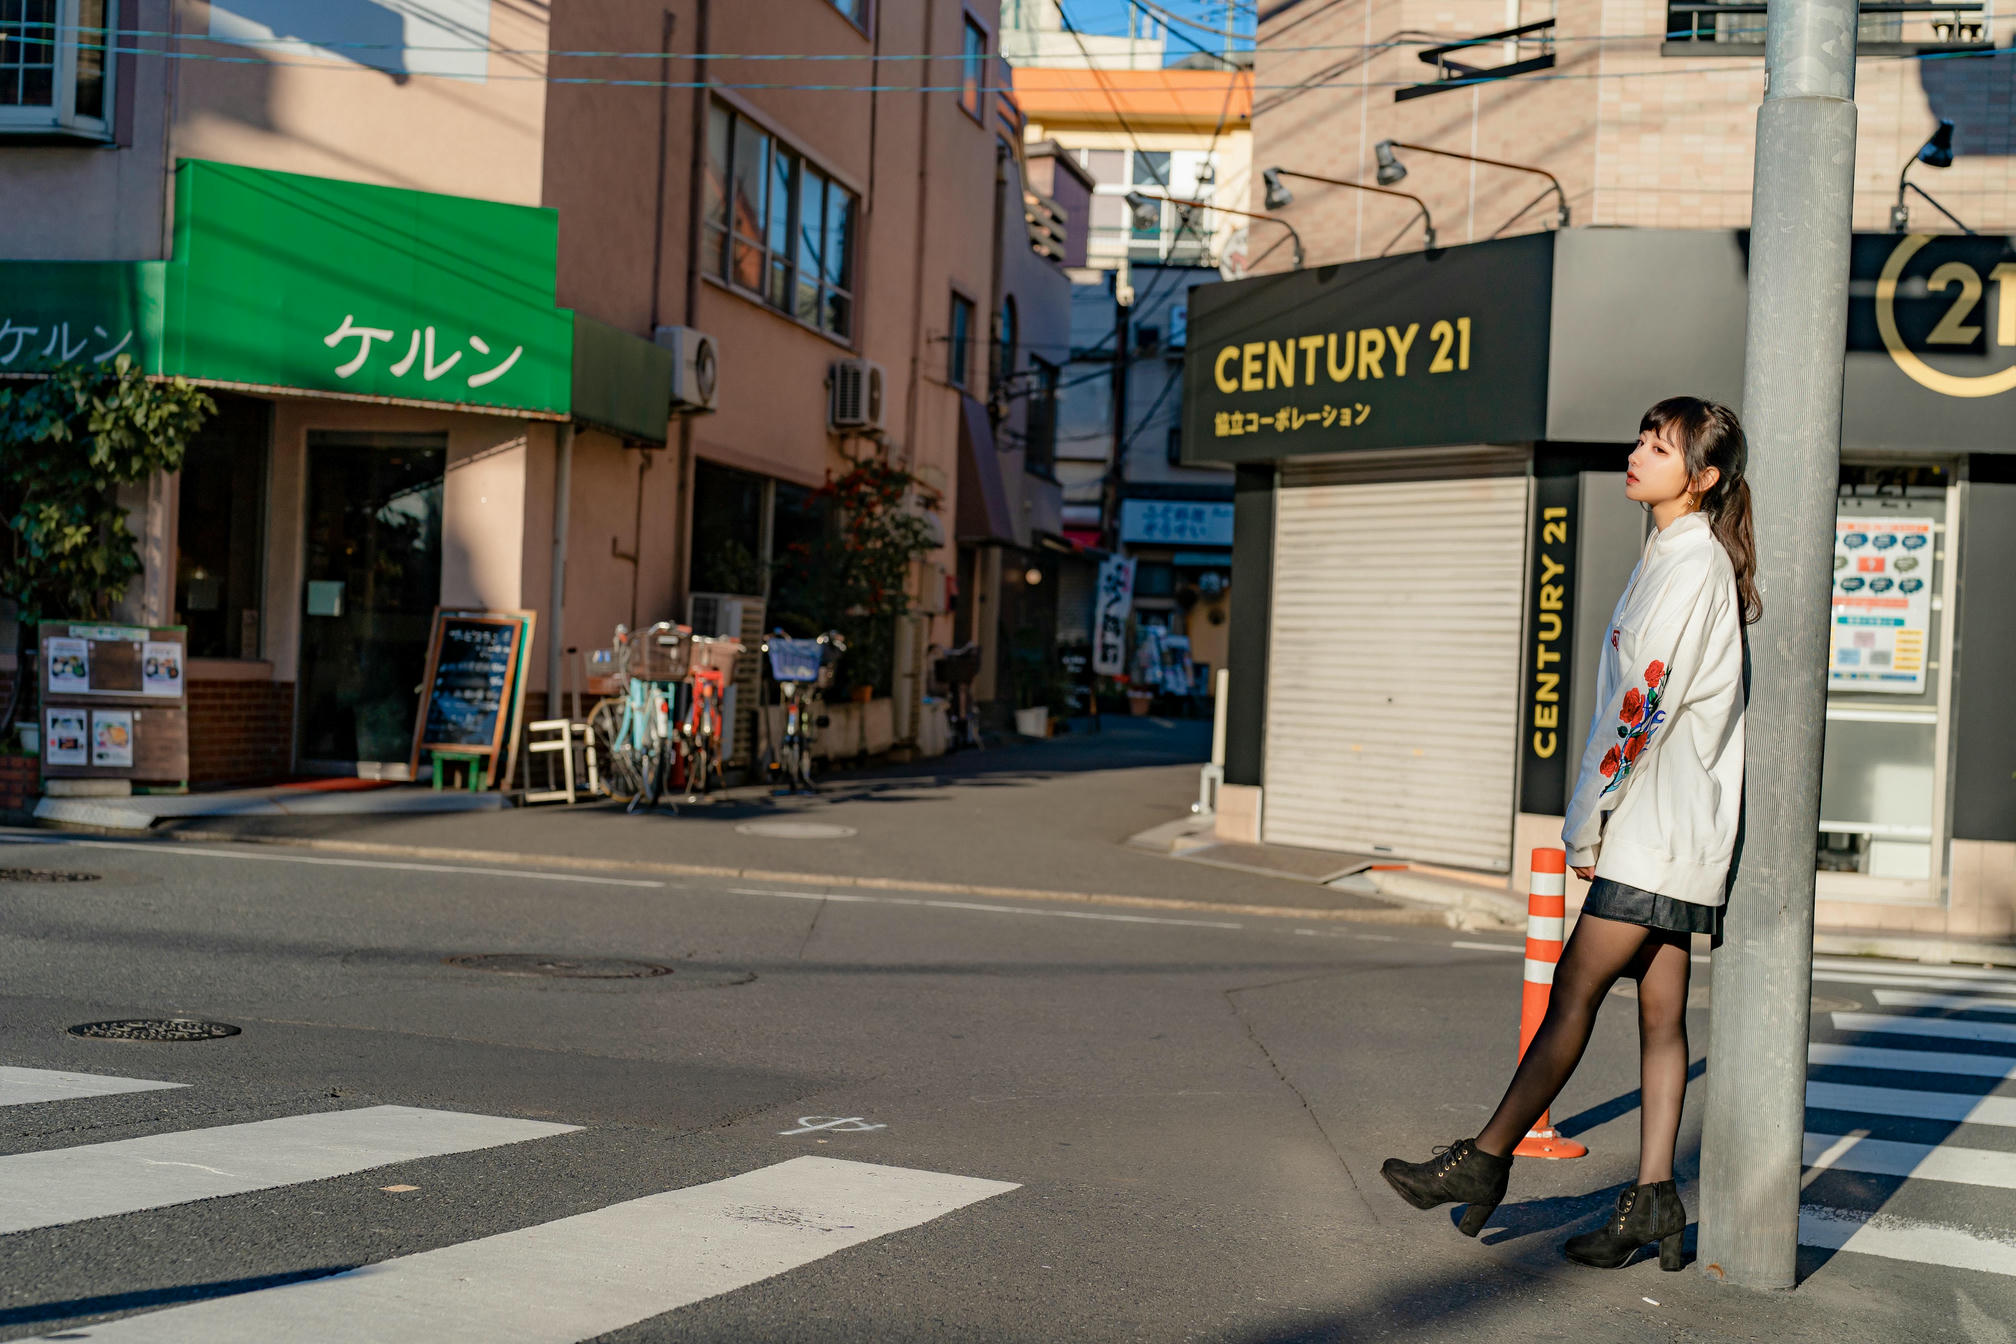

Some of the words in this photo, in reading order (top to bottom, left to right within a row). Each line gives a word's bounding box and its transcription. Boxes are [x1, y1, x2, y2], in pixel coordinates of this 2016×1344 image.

[0, 318, 133, 365] ケルン
[324, 314, 523, 388] ケルン
[1214, 323, 1420, 394] CENTURY
[1428, 316, 1471, 374] 21
[1542, 507, 1568, 545] 21
[1533, 553, 1565, 759] CENTURY
